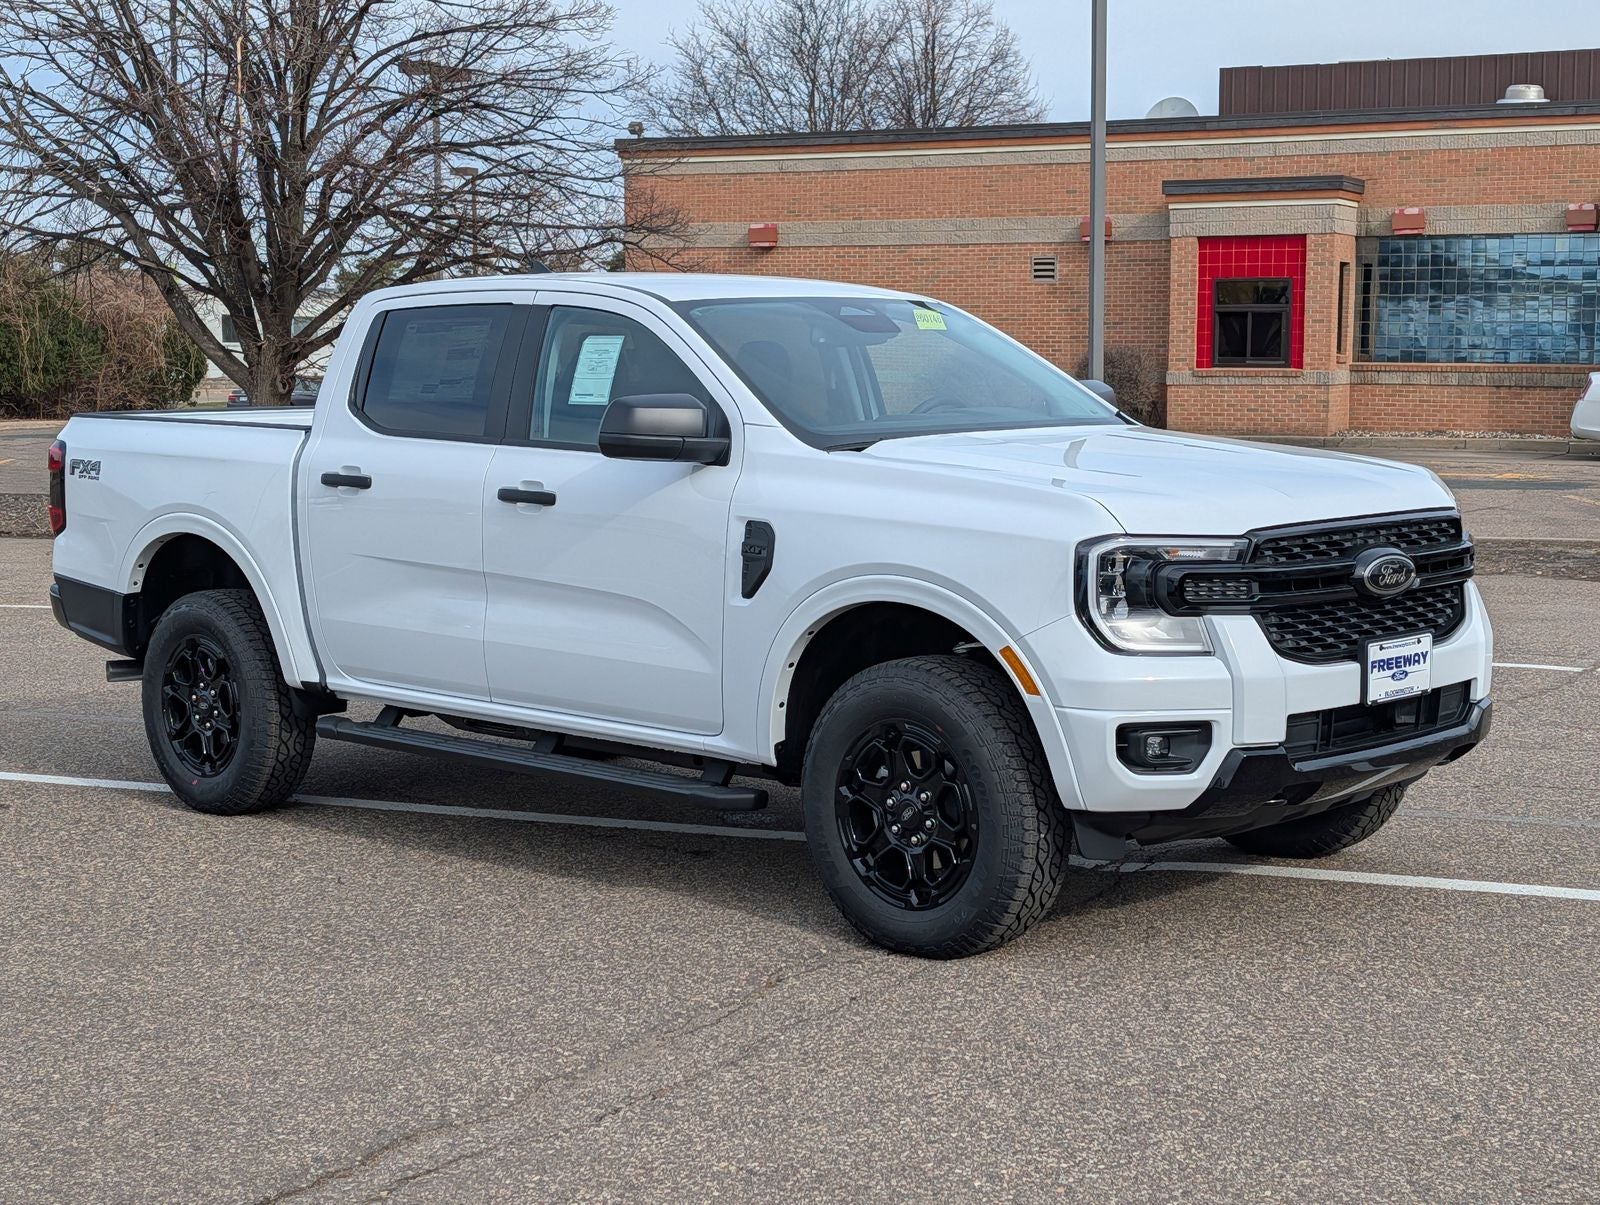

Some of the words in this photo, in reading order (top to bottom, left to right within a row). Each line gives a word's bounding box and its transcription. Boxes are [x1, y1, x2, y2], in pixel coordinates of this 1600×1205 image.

[69, 458, 101, 475] FX4
[1379, 563, 1406, 586] Ford
[1370, 650, 1429, 674] FREEWAY
